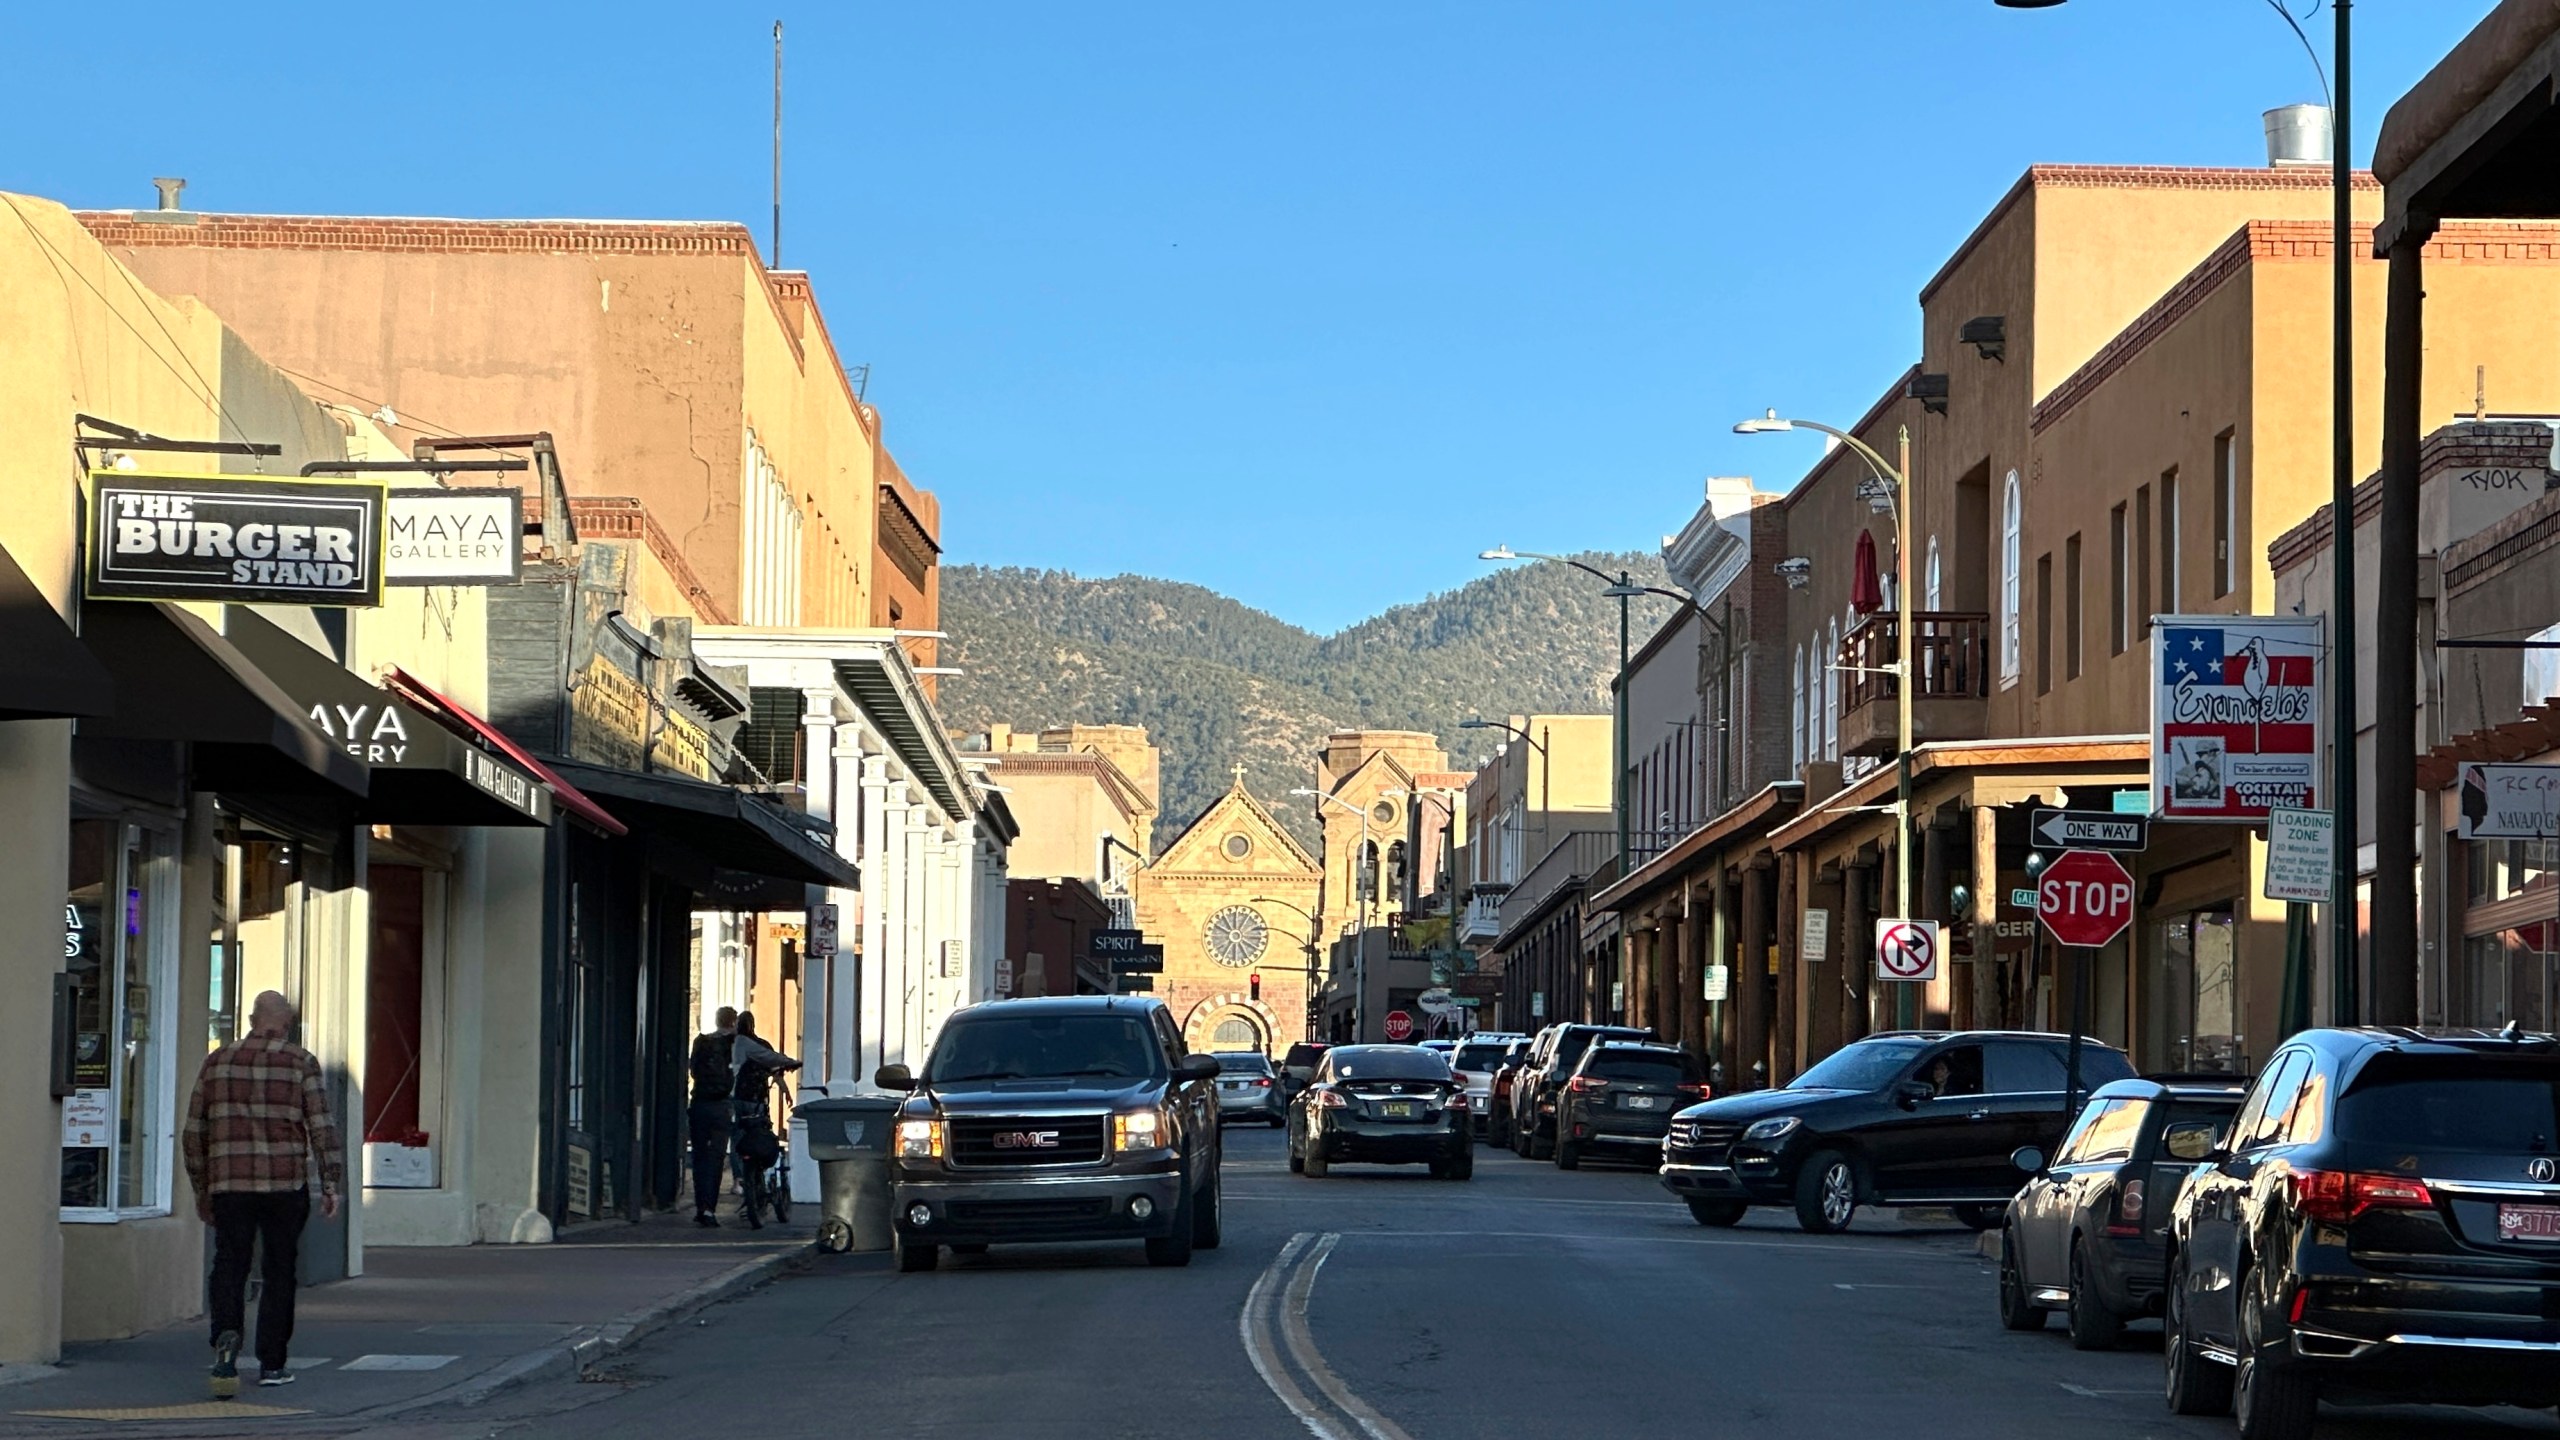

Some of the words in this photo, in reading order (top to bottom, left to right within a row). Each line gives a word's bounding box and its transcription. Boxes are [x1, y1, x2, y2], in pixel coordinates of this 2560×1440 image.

[2461, 469, 2528, 491] TYOK
[117, 494, 194, 519] THE
[390, 514, 504, 541] MAYA
[116, 519, 354, 562] BURGER
[390, 544, 505, 558] GALLERY
[232, 560, 353, 587] STAND
[495, 766, 525, 808] GALLERY
[2234, 782, 2308, 796] COCKTAIL
[2240, 795, 2305, 808] LOUNGE
[2278, 814, 2332, 829] LOADING
[2498, 811, 2542, 829] NAVAJO
[2066, 823, 2096, 837] ONE
[2102, 825, 2133, 839] WAY
[2288, 828, 2320, 841] ZONE
[2041, 880, 2131, 917] STOP
[1095, 936, 1137, 950] SPIRIT
[1387, 1019, 1410, 1031] STOP
[994, 1131, 1059, 1148] GMC
